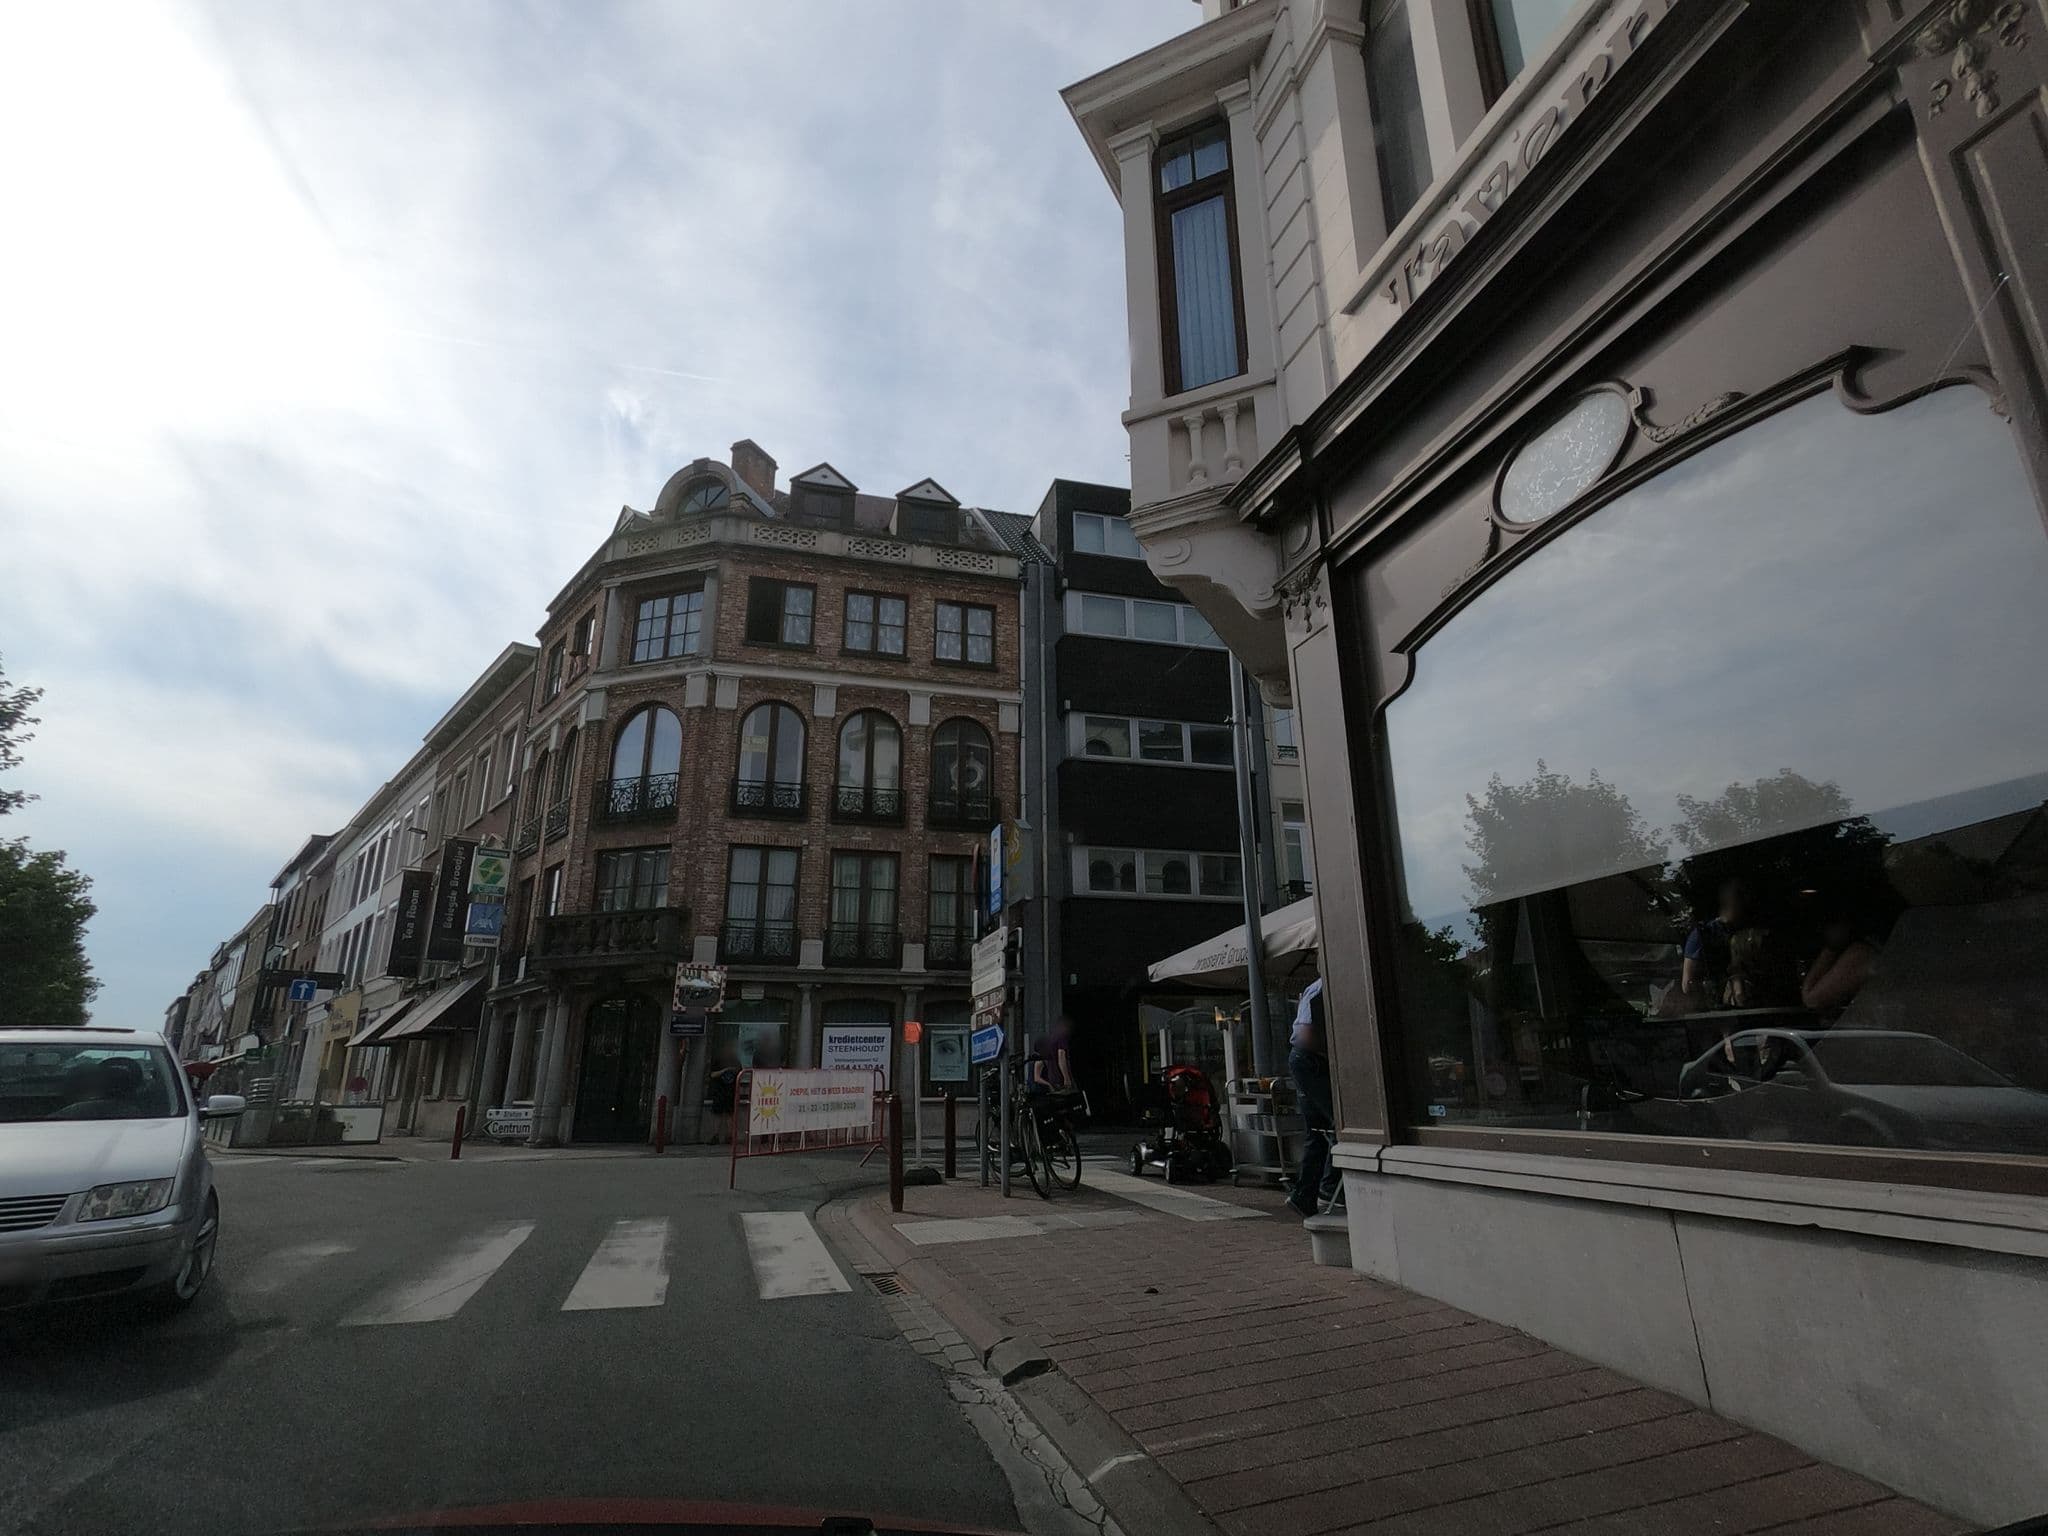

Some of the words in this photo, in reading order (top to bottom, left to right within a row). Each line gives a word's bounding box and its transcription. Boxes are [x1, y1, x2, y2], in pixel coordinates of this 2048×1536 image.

[449, 846, 467, 887] Broodjes
[406, 889, 421, 919] Room
[443, 890, 458, 929] Belegde
[401, 921, 415, 941] Tea
[828, 1035, 886, 1044] kredietcenter
[828, 1045, 885, 1053] STEENHOUDT
[492, 1122, 531, 1134] Centrum
